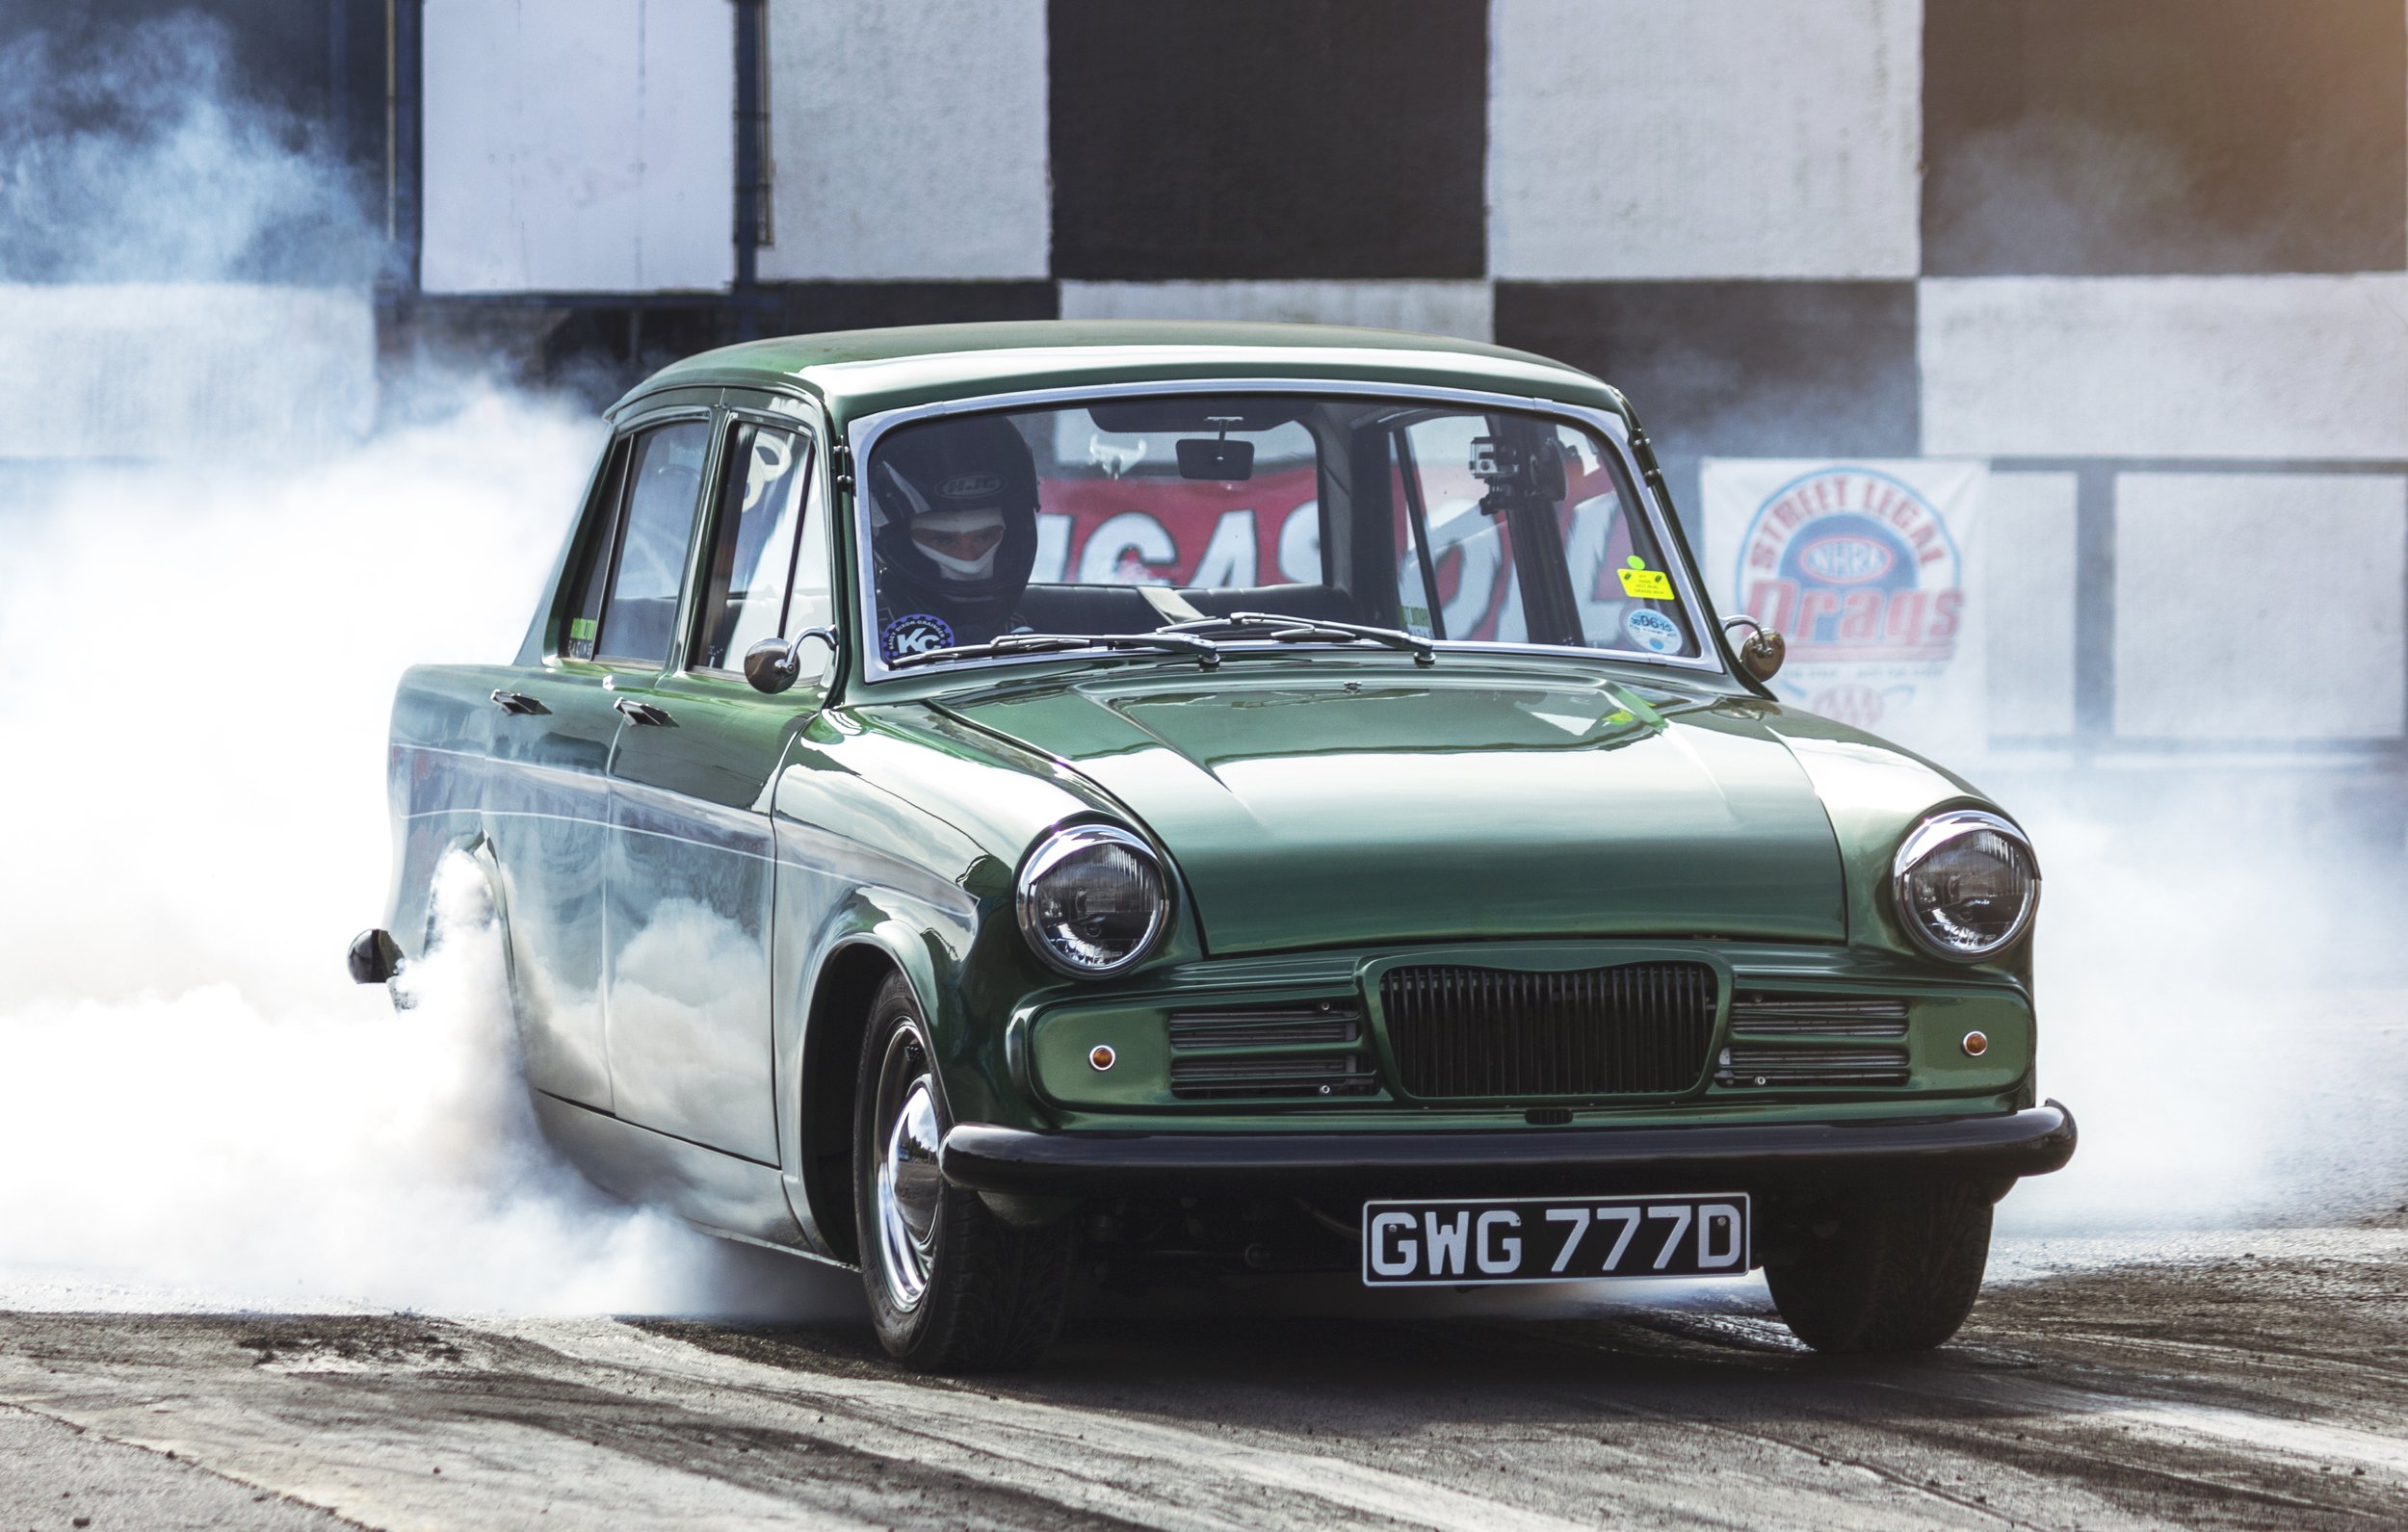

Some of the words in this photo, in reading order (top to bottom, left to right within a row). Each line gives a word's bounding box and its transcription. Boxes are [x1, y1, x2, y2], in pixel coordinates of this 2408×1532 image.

[1750, 478, 1849, 569] STREET
[1862, 481, 1947, 567] LEGAL
[897, 627, 941, 654] KC
[1371, 1209, 1522, 1276] GWG
[1545, 1204, 1741, 1273] 777D
